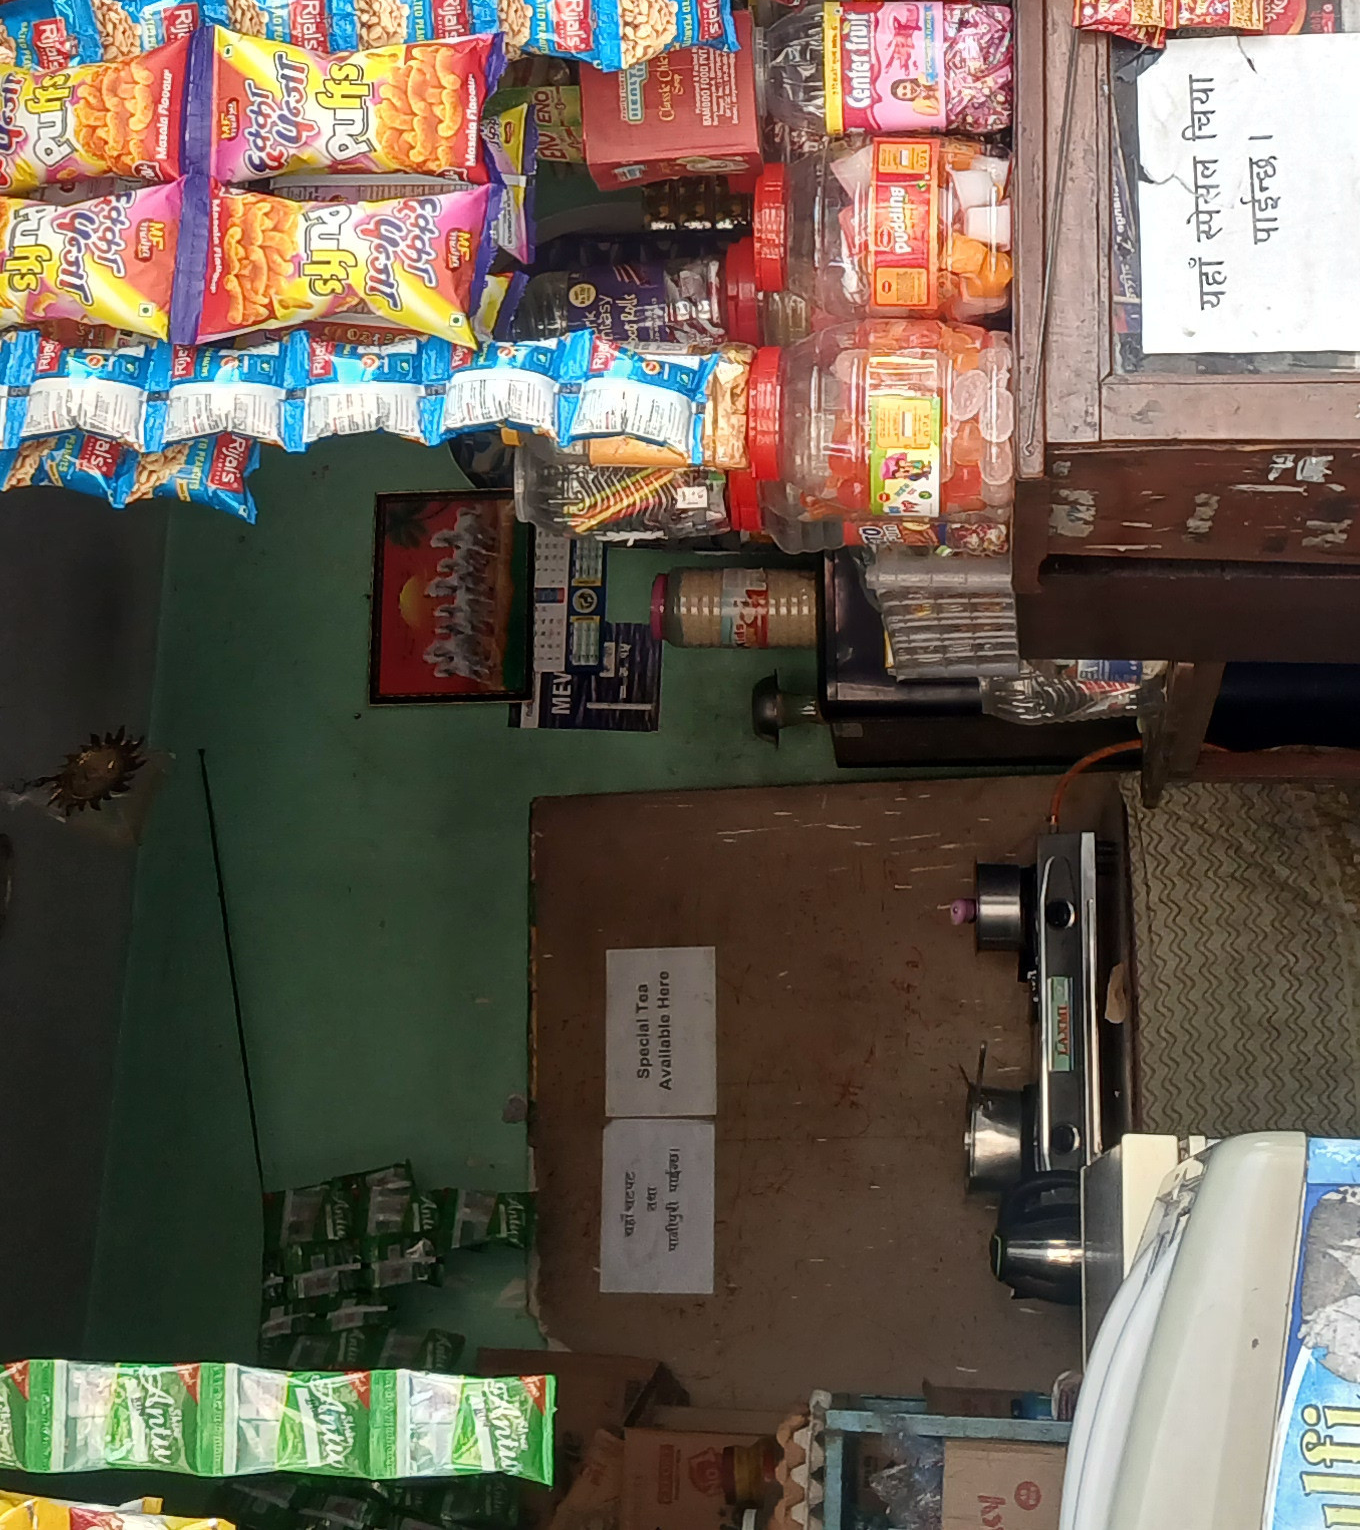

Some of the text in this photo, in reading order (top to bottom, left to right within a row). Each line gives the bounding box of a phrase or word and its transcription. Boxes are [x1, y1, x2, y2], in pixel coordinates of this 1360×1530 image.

[700, 66, 710, 88] FOOD
[842, 11, 871, 108] Center fruit
[155, 69, 174, 159] Masala Flavour
[464, 73, 478, 167] Masala Flavour
[534, 90, 553, 123] ENO
[538, 132, 567, 158] ENO
[1181, 74, 1218, 141] चिया
[1240, 156, 1280, 244] पाईन्छ
[1188, 257, 1227, 310] यहाँ
[636, 984, 652, 1079] Special Tea
[657, 971, 672, 1091] Available Here
[1055, 1005, 1070, 1056] LAXMI
